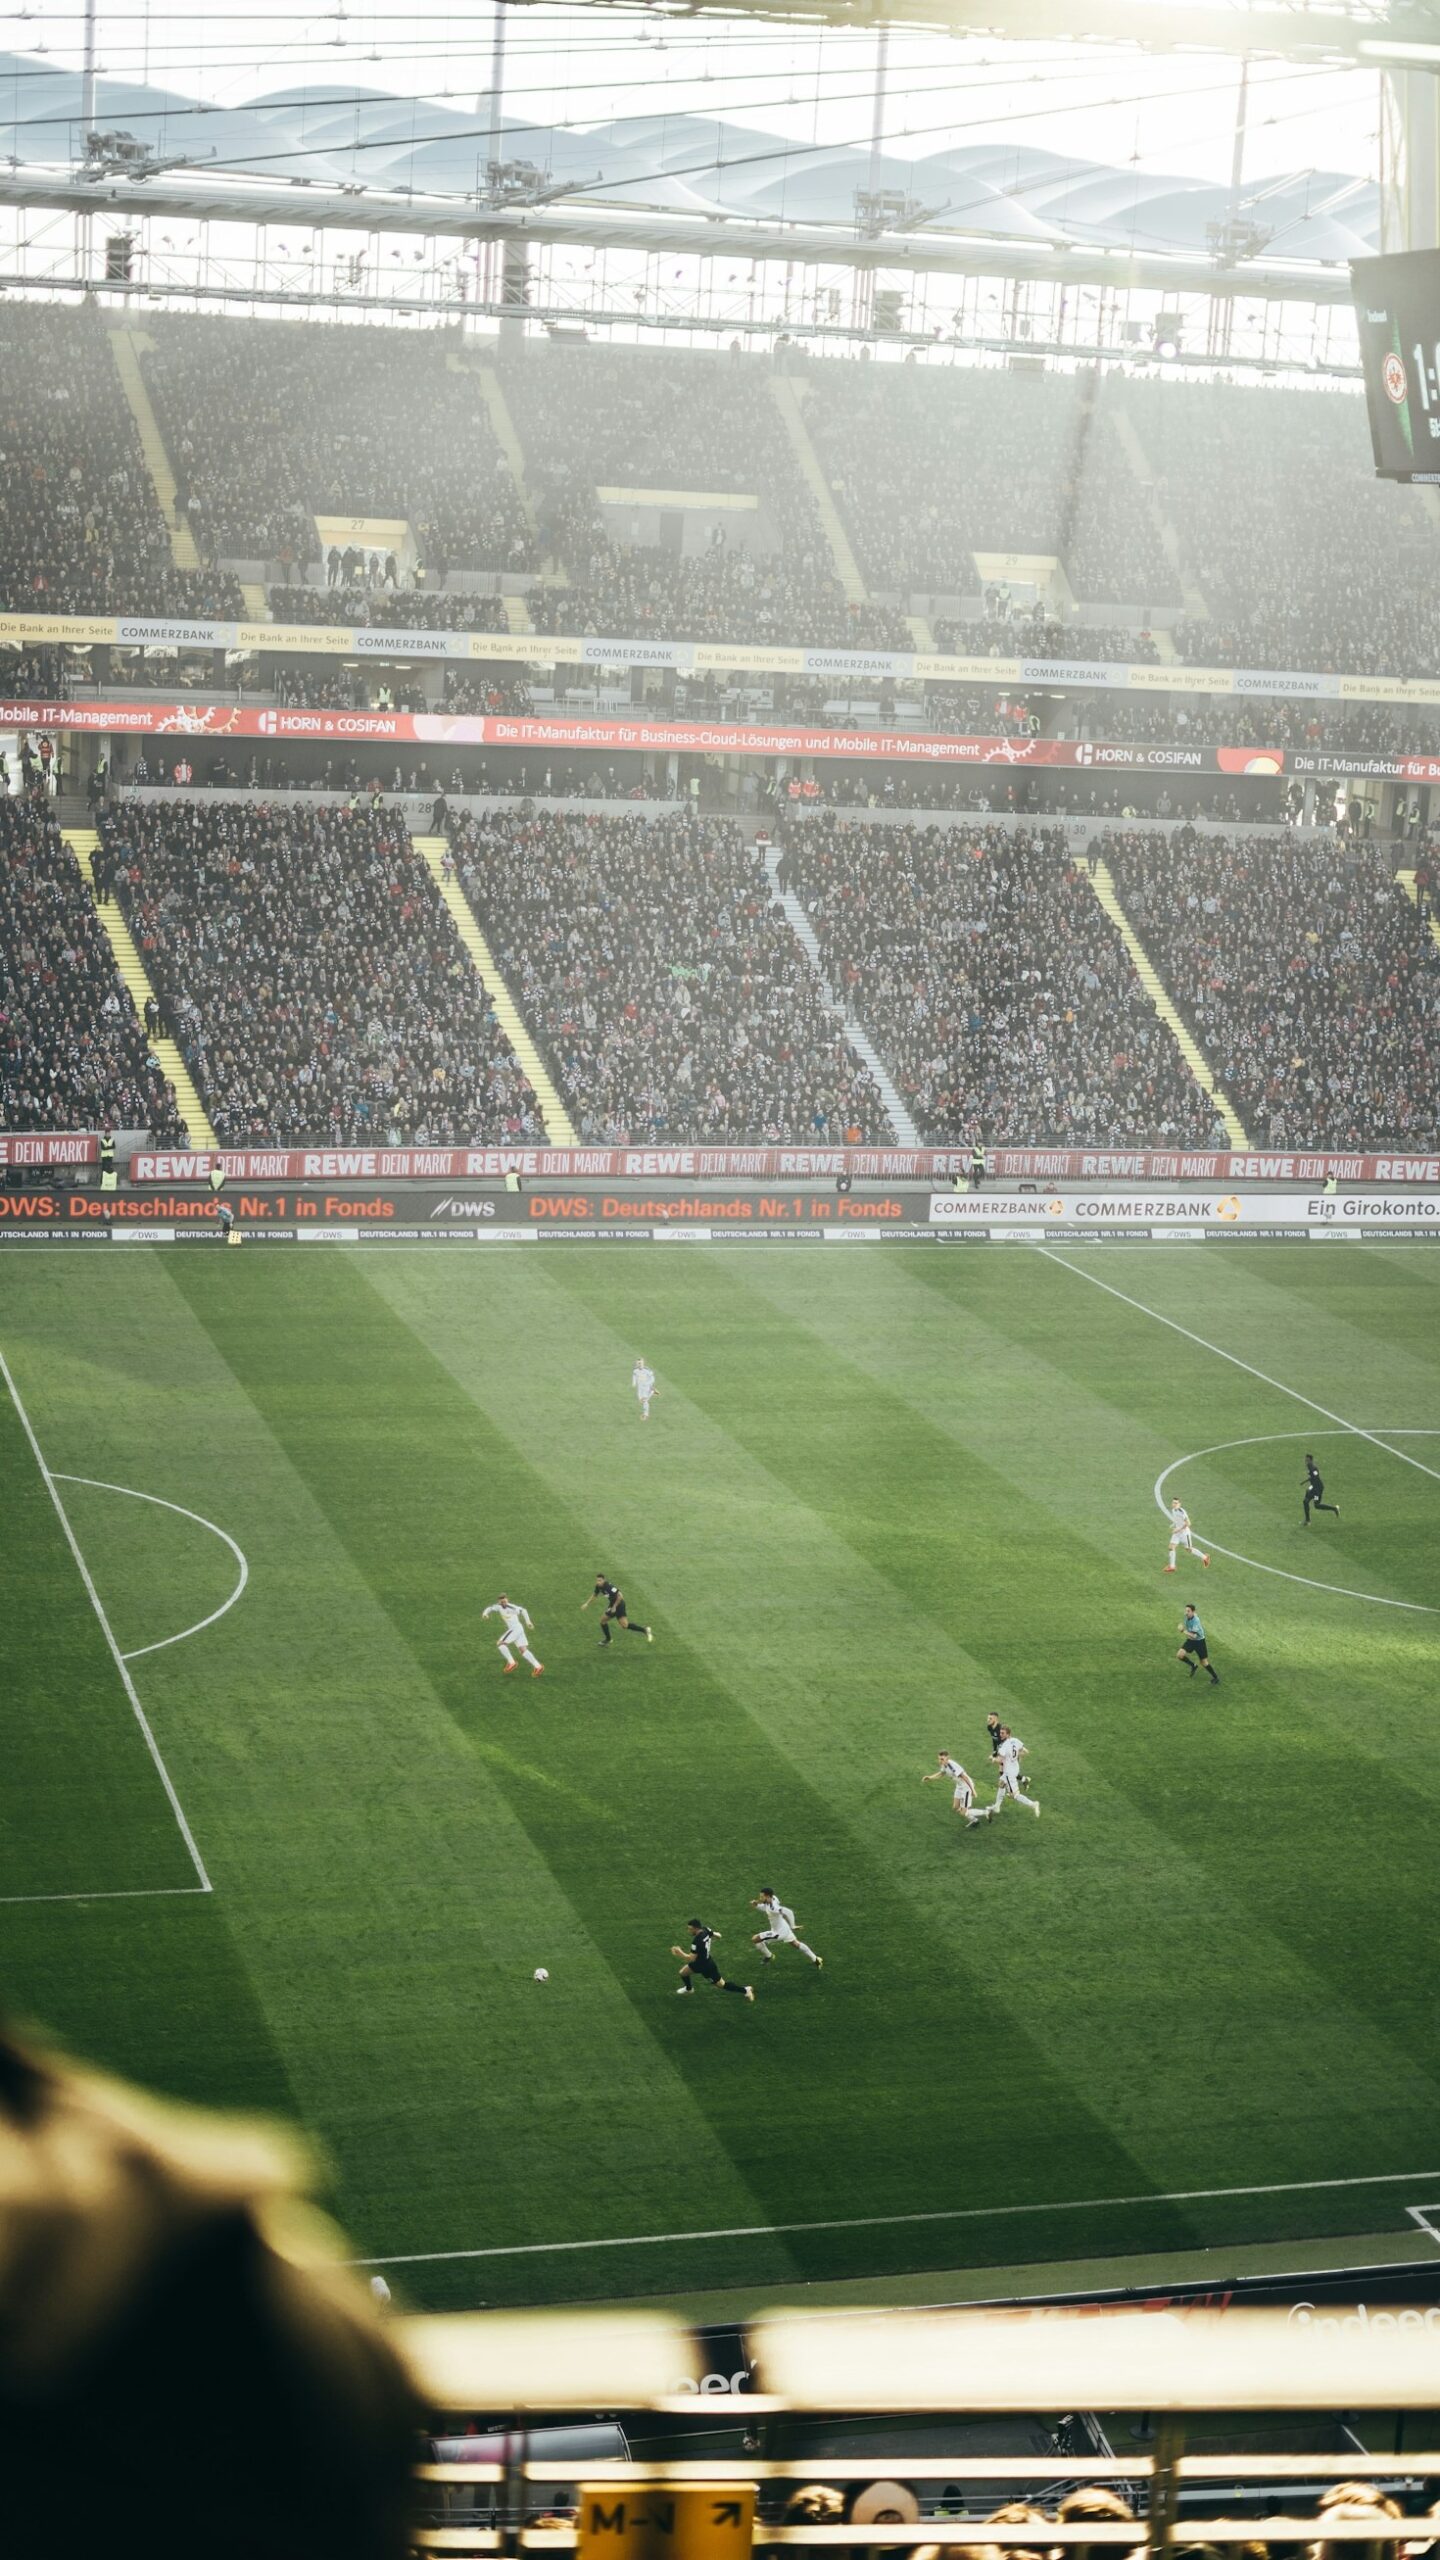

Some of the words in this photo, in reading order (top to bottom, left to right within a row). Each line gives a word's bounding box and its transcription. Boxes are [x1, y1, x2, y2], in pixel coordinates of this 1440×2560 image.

[1414, 343, 1440, 410] 1:
[351, 519, 364, 530] 27
[0, 622, 17, 632] Die
[19, 623, 45, 634] Bank
[62, 624, 86, 635] Ihrer
[88, 625, 113, 636] Seite
[121, 627, 215, 641] COMMERZBANK
[241, 632, 257, 642] Die
[258, 633, 282, 643] Bank
[300, 634, 323, 645] Ihrer
[326, 635, 349, 646] Seite
[357, 637, 447, 650] COMMERZBANK
[472, 642, 488, 652] Die
[491, 643, 513, 653] Bank
[515, 646, 528, 654] an
[530, 644, 551, 656] Ihrer
[554, 646, 578, 656] Seite
[586, 647, 672, 661] COMMERZBANK
[697, 652, 712, 662] Die
[714, 653, 738, 663] Bank
[753, 654, 775, 665] Ihrer
[777, 655, 800, 665] Seite
[807, 657, 892, 671] COMMERZBANK
[916, 662, 931, 672] Die
[934, 663, 956, 673] Bank
[971, 664, 993, 676] Ihrer
[995, 665, 1017, 676] Seite
[1024, 667, 1107, 681] COMMERZBANK
[1131, 672, 1146, 682] Die
[1148, 672, 1170, 684] Bank
[1172, 676, 1183, 684] an
[1185, 674, 1206, 687] Ihrer
[1208, 675, 1230, 686] Seite
[1237, 678, 1318, 691] COMMERZBANK
[1343, 682, 1358, 693] Die
[1361, 683, 1383, 694] Bank
[1385, 687, 1394, 695] an
[1396, 685, 1417, 697] Ihrer
[1419, 686, 1440, 697] Seite
[43, 708, 153, 726] IT-Management
[282, 716, 321, 731] HORN
[325, 720, 334, 731] &
[338, 718, 396, 734] COSIFAN
[496, 724, 518, 738] Die
[521, 724, 615, 741] IT-Manufaktur
[618, 726, 637, 742] für
[641, 728, 801, 749] Business-Cloud-Lösungen
[805, 737, 829, 749] und
[834, 736, 878, 751] Mobile
[881, 740, 980, 758] IT-Management
[1096, 749, 1133, 763] HORN
[1136, 752, 1145, 763] &
[1148, 750, 1201, 766] COSIFAN
[1295, 757, 1315, 770] Die
[1318, 757, 1405, 775] IT-Manufaktur
[1407, 761, 1426, 776] für
[418, 802, 431, 813] 28
[15, 1141, 44, 1163] DEIN
[49, 1141, 90, 1163] MARKT
[137, 1156, 211, 1178] REWE
[250, 1155, 290, 1176] MARKT
[305, 1154, 375, 1175] REWE
[382, 1155, 409, 1175] DEIN
[414, 1154, 453, 1175] MARKT
[467, 1153, 536, 1173] REWE
[543, 1153, 569, 1173] DEIN
[574, 1153, 612, 1173] MARKT
[626, 1152, 694, 1173] REWE
[701, 1153, 726, 1173] DEIN
[731, 1153, 768, 1173] MARKT
[781, 1153, 845, 1173] REWE
[853, 1153, 877, 1174] DEIN
[880, 1153, 920, 1174] MARKT
[1004, 1154, 1028, 1175] DEIN
[1032, 1154, 1071, 1175] MARKT
[1081, 1155, 1145, 1175] REWE
[1152, 1156, 1177, 1176] DEIN
[1181, 1157, 1218, 1177] MARKT
[1229, 1157, 1293, 1178] REWE
[1299, 1158, 1325, 1178] DEIN
[1328, 1159, 1364, 1179] MARKT
[1375, 1160, 1439, 1181] REWE
[0, 1197, 60, 1217] DWS:
[240, 1198, 286, 1217] Nr.1
[296, 1198, 317, 1217] in
[325, 1198, 394, 1217] Fonds
[451, 1201, 496, 1217] DWS
[530, 1198, 594, 1217] DWS:
[602, 1199, 752, 1217] Deutschlands
[759, 1199, 802, 1217] Nr.1
[811, 1199, 830, 1217] in
[838, 1199, 902, 1217] Fonds
[934, 1202, 1046, 1214] COMMERZBANK
[1075, 1202, 1211, 1216] COMMERZBANK
[1307, 1200, 1336, 1216] Ein
[1343, 1200, 1440, 1216] Girokonto.
